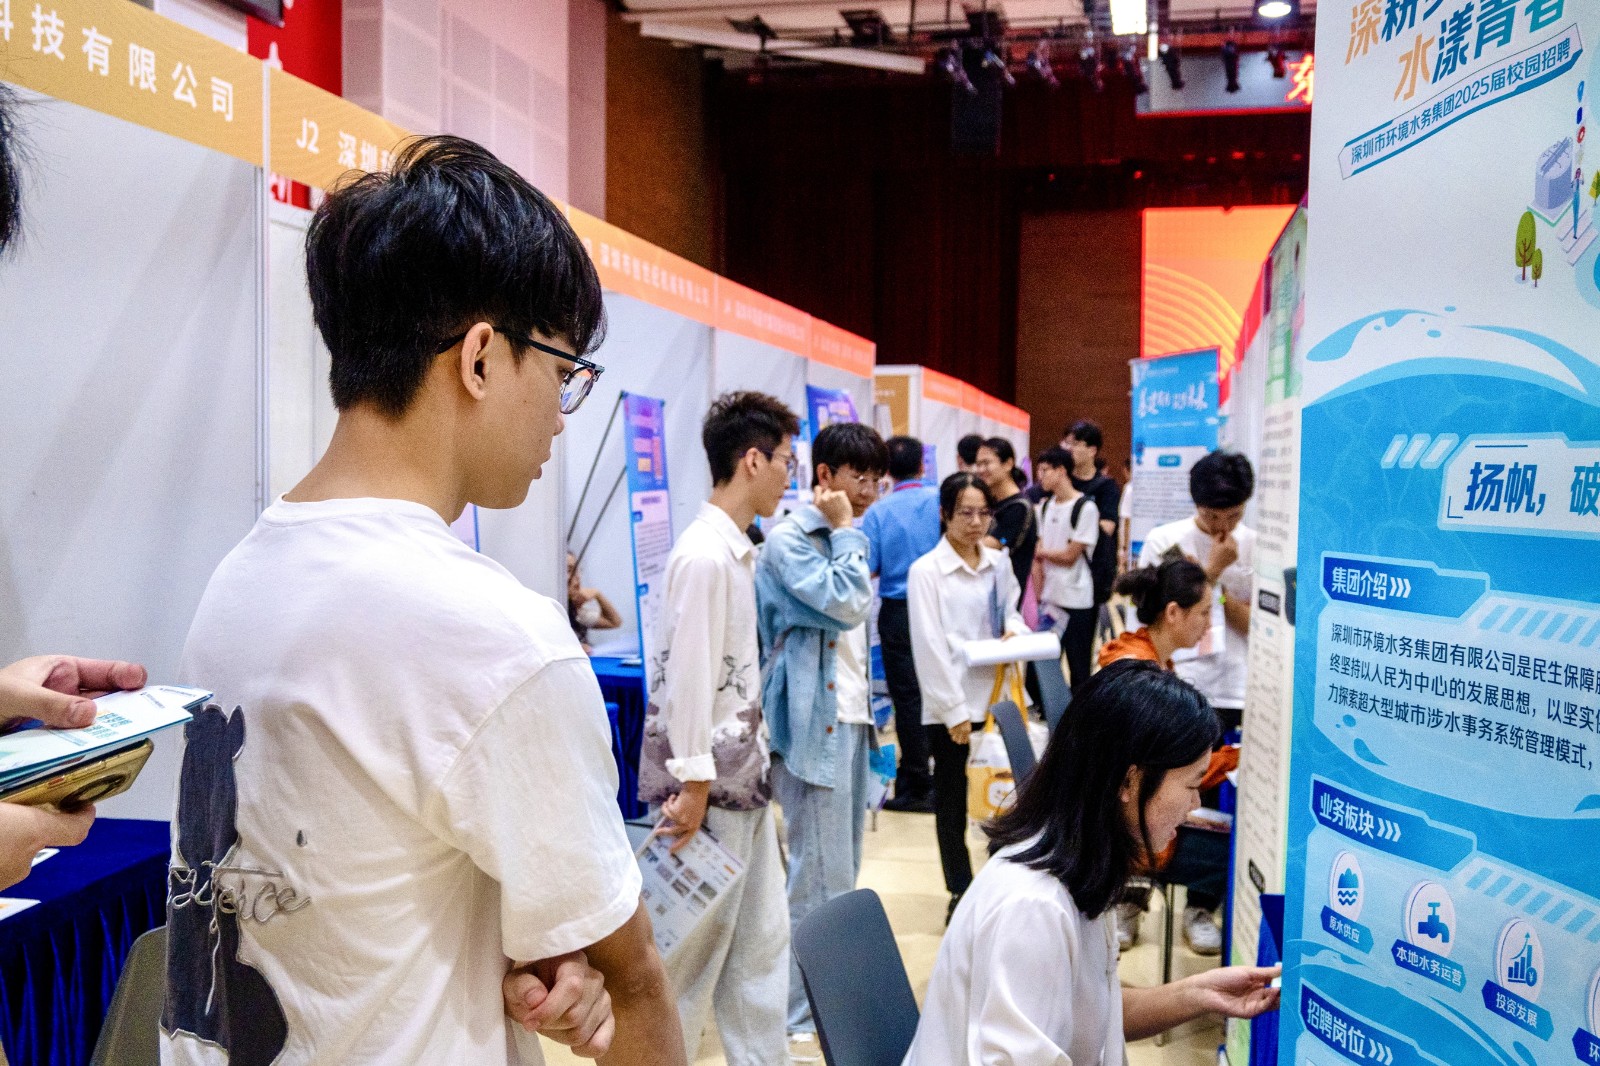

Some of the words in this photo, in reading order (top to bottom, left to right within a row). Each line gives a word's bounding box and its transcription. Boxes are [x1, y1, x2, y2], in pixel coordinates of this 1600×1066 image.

[1350, 37, 1570, 165] 深圳市环境水务集团2025届校园招聘
[296, 118, 319, 154] J2
[1331, 566, 1387, 600] 集团介绍
[1319, 792, 1375, 840] 业务板块
[1328, 915, 1360, 945] 原水供应
[1396, 946, 1462, 987] 本地水务运营
[1307, 997, 1365, 1059] 招聘岗位
[1496, 991, 1538, 1029] 投资发展
